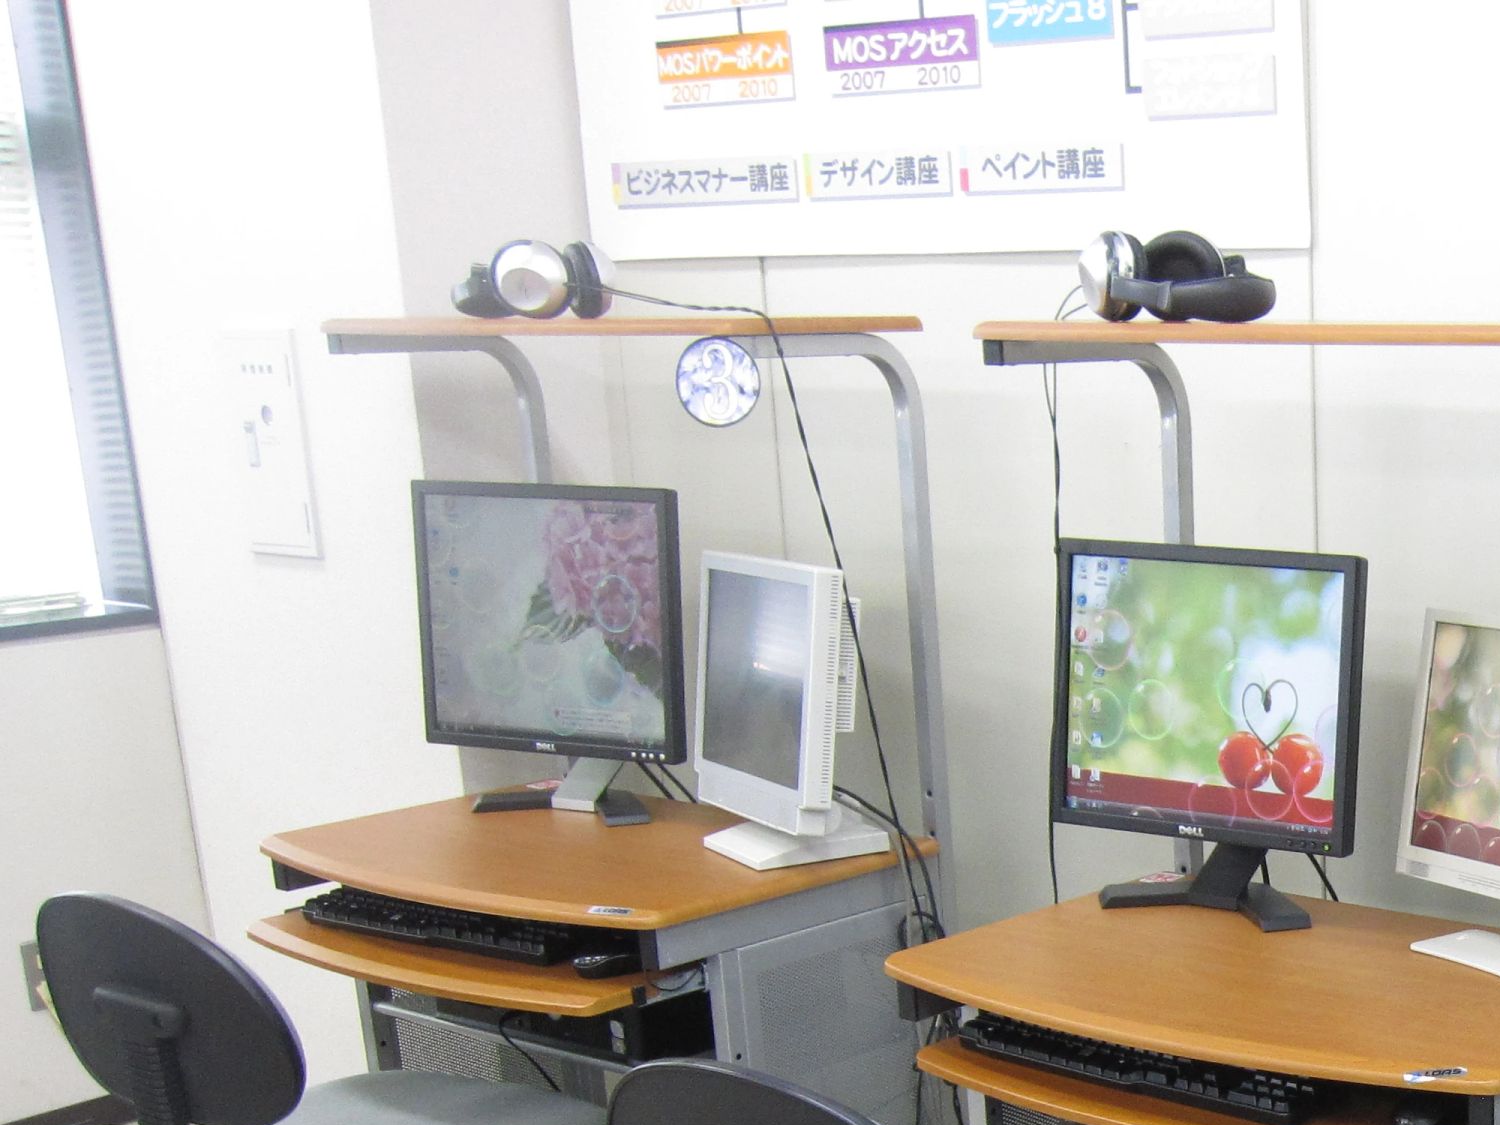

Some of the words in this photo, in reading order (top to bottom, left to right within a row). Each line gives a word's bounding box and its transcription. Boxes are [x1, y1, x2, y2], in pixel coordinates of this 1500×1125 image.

[658, 40, 790, 77] MOSパワーポイント
[832, 27, 969, 65] MOSアクセス
[671, 83, 711, 103] 2007
[738, 78, 778, 98] 2010
[840, 70, 886, 91] 2007
[917, 64, 961, 86] 2010
[626, 161, 790, 196] ビジネスマナー講座
[819, 154, 940, 188] デザイン講座
[981, 146, 1106, 180] ペイント講座
[702, 342, 738, 420] 3
[1178, 825, 1204, 837] DELL
